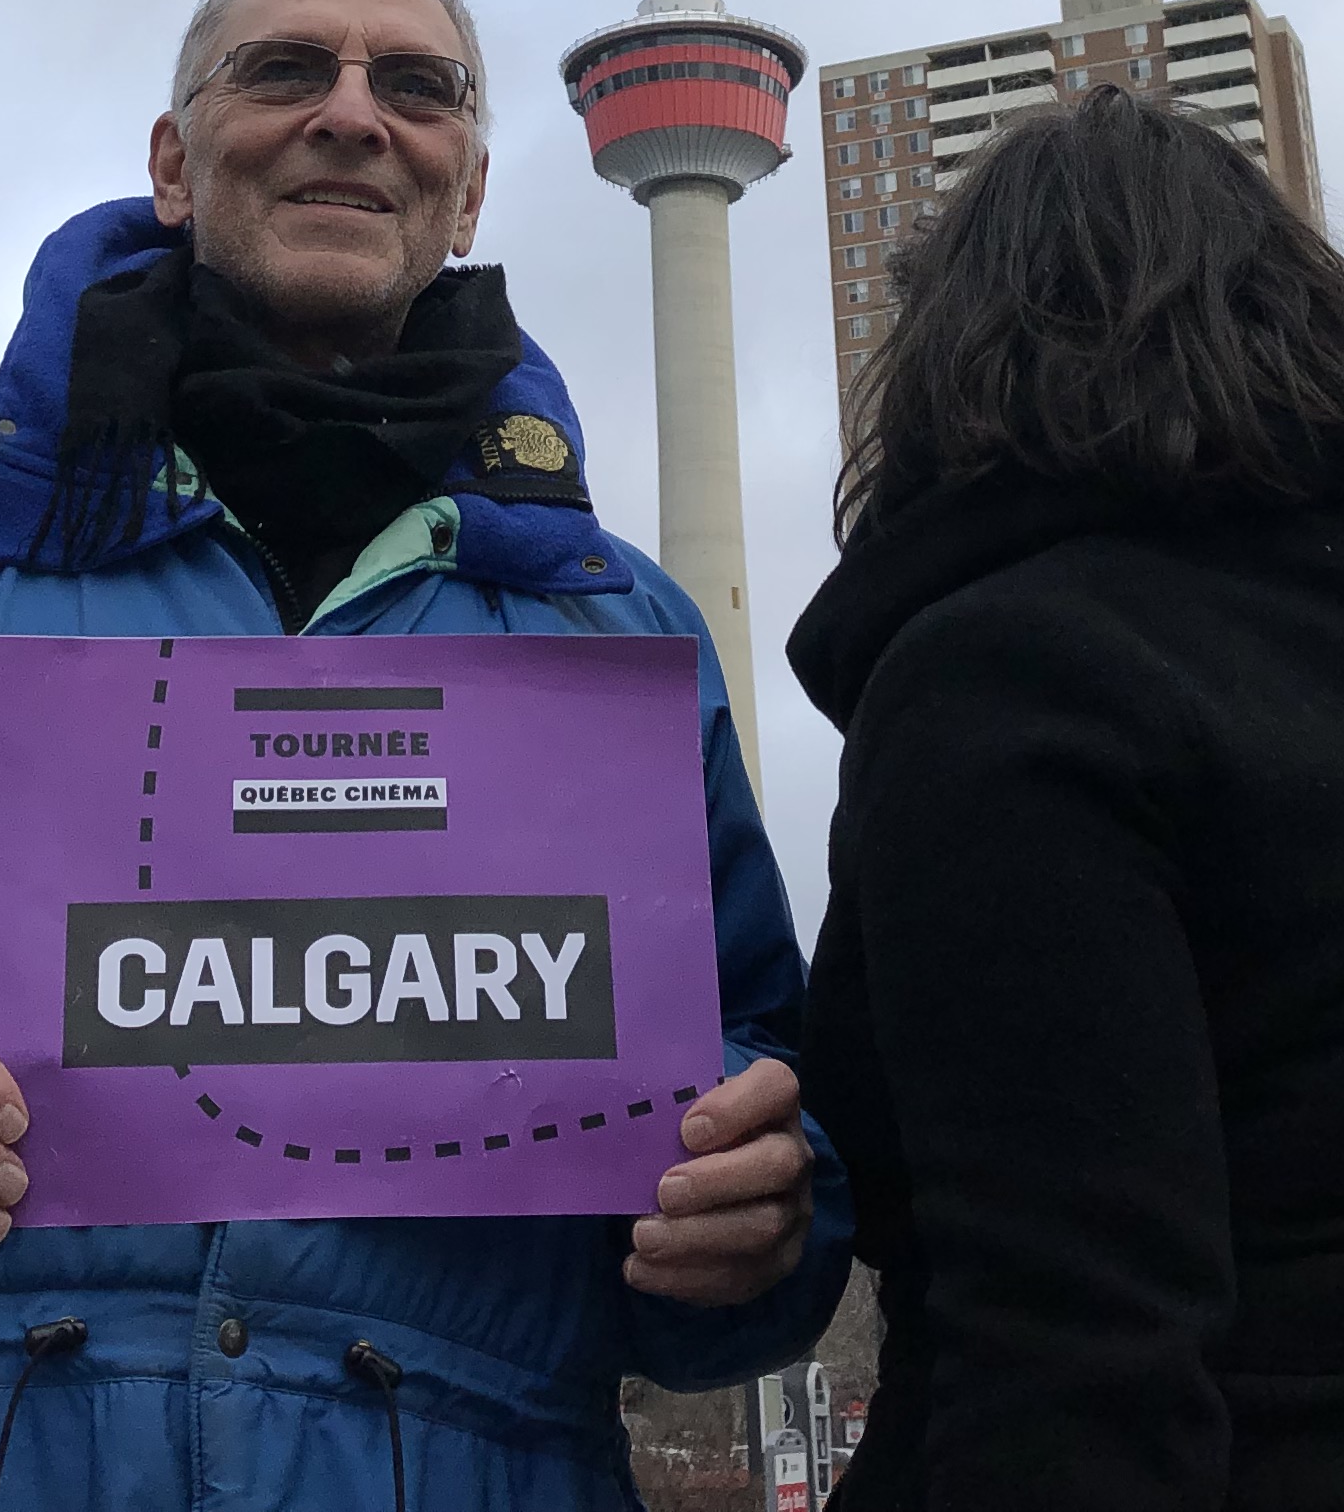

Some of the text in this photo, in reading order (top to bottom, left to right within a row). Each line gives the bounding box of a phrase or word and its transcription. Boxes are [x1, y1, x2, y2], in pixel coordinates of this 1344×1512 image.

[249, 730, 430, 758] TOURNÉE
[240, 784, 440, 805] QUÉBEC CINÉMA
[97, 933, 586, 1028] CALGARY
